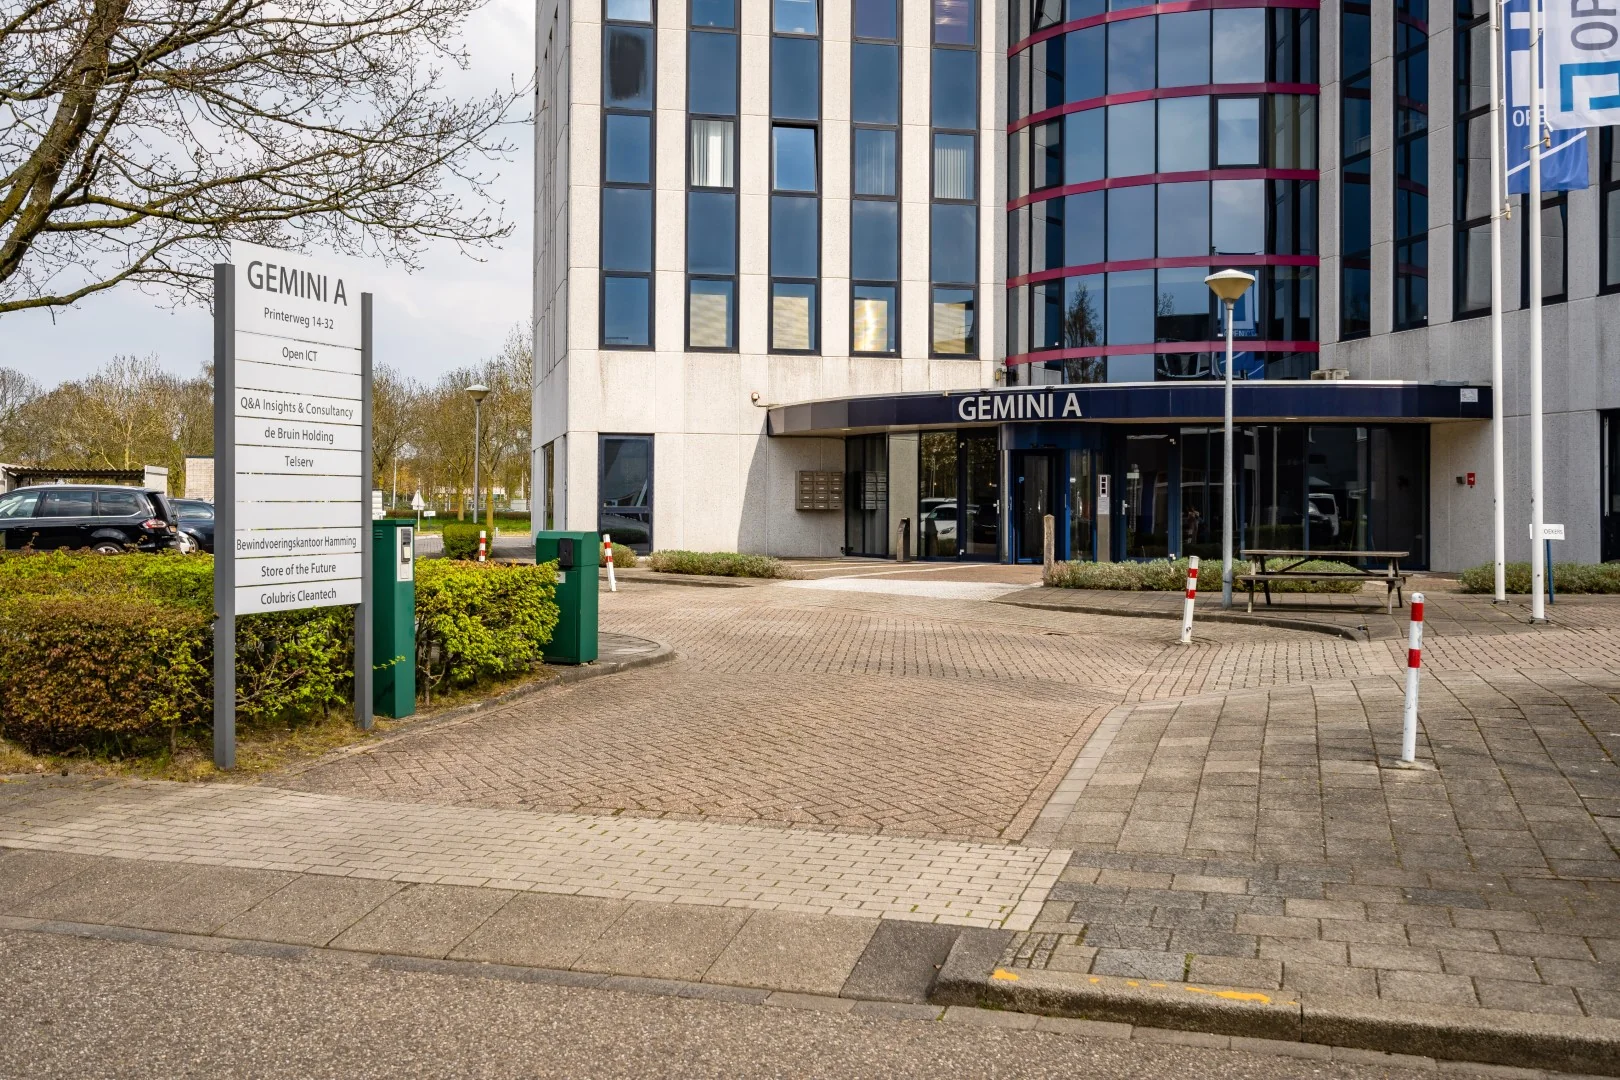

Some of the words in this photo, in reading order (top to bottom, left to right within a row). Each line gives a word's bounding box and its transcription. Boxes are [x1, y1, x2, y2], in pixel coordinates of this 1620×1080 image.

[247, 260, 328, 303] GEMINI
[333, 278, 348, 306] A
[264, 306, 310, 328] Printerweg
[312, 316, 334, 330] 14-32
[282, 346, 304, 361] Open
[305, 350, 318, 362] ICT
[240, 396, 261, 410] Q&A
[263, 399, 296, 415] Insights
[297, 402, 304, 414] &
[306, 403, 353, 420] Consultancy
[958, 393, 1054, 420] GEMINI
[1061, 392, 1083, 418] A
[264, 427, 276, 439] de
[277, 428, 300, 441] Bruin
[302, 429, 334, 445] Holding
[284, 455, 314, 468] Telserv
[236, 538, 324, 551] Bewindvoeringskantoor
[324, 536, 357, 548] Hamming
[261, 565, 284, 577] Store
[285, 564, 295, 576] of
[295, 563, 309, 575] the
[310, 563, 337, 574] Future
[260, 591, 296, 605] Colubris
[297, 588, 337, 602] Cleantech
